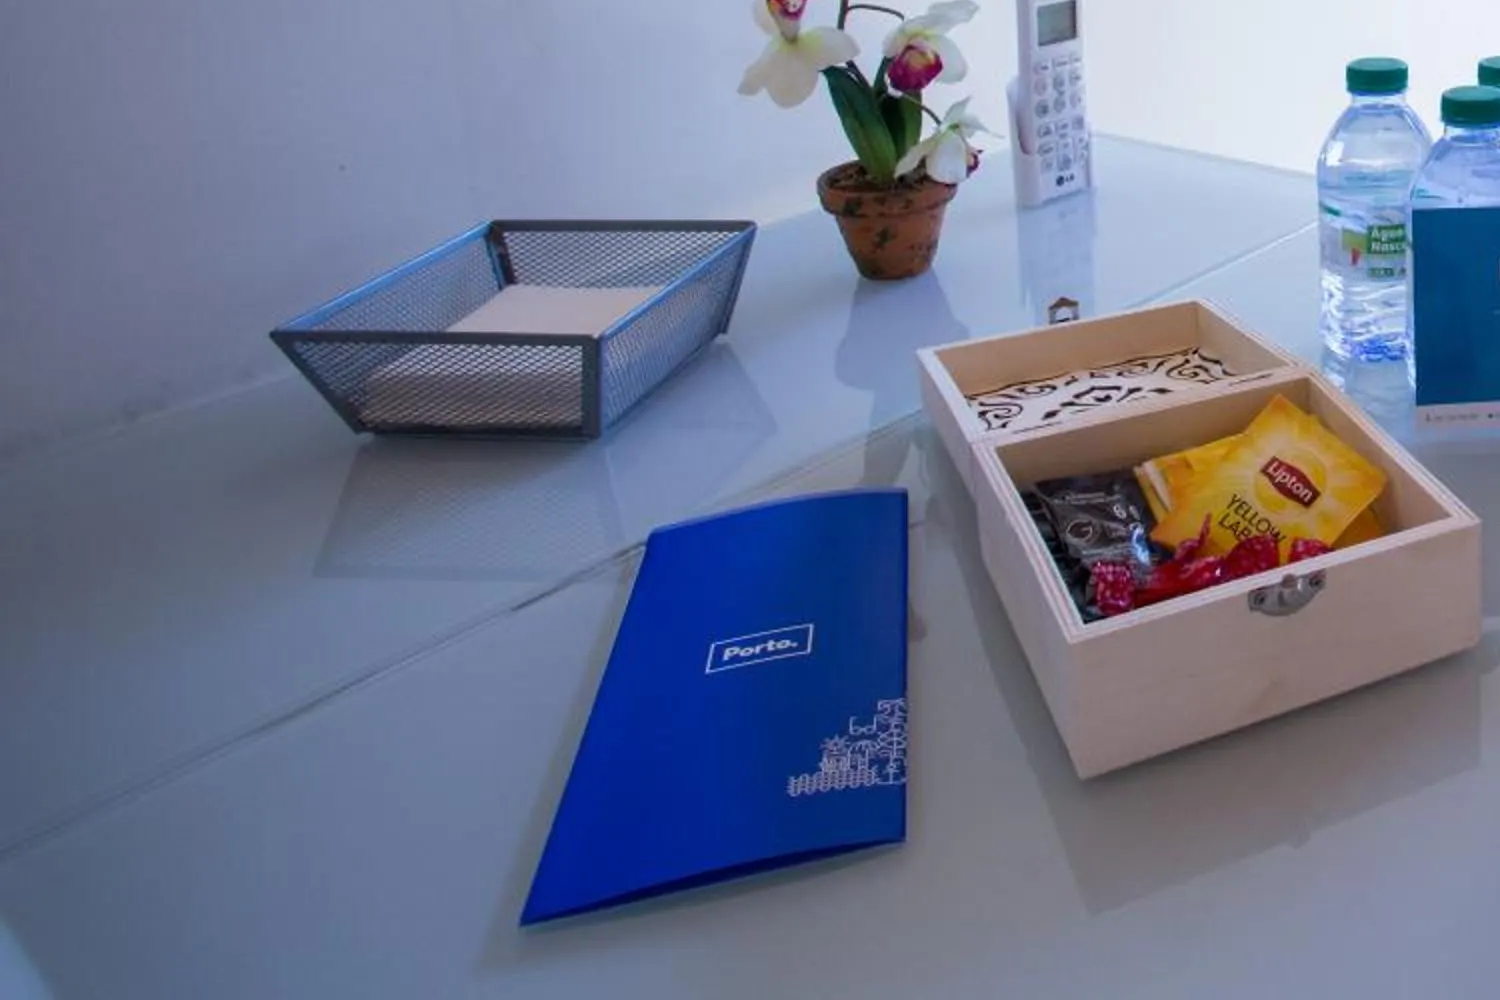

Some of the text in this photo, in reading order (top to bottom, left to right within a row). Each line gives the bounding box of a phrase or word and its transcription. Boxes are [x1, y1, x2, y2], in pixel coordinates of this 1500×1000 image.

[1266, 461, 1313, 502] Lipton
[1218, 512, 1254, 540] LAB
[1226, 494, 1287, 542] YELLOW
